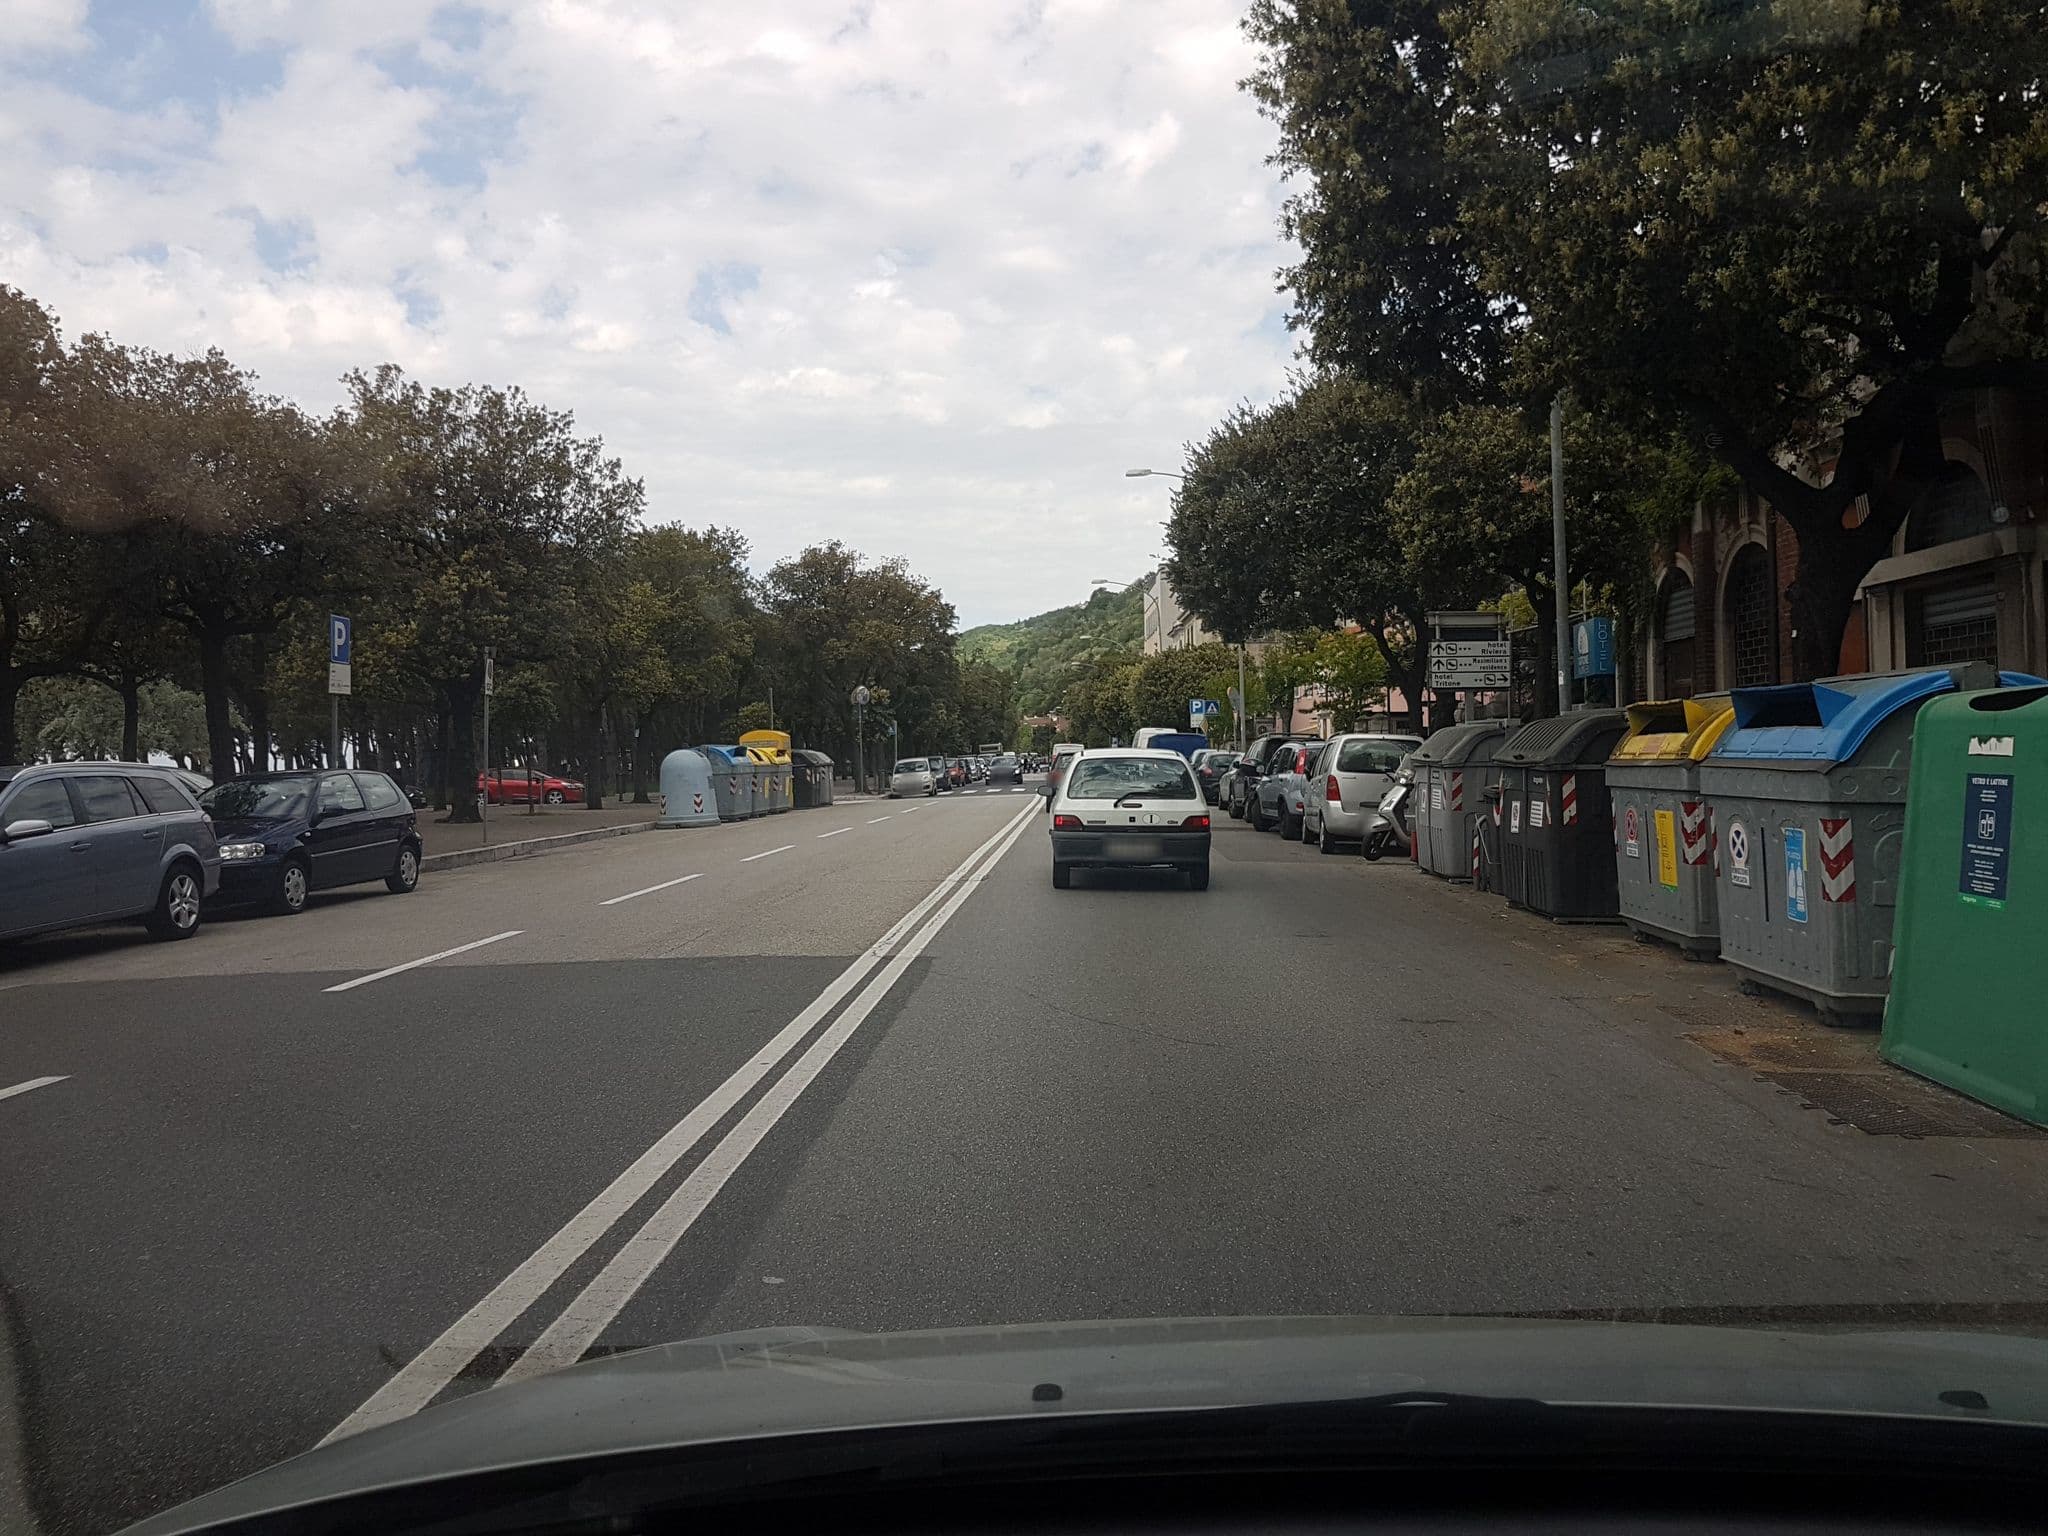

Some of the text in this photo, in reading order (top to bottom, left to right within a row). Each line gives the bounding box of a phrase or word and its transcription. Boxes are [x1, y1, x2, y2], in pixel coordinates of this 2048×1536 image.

[334, 620, 346, 657] P
[1598, 621, 1608, 671] HOTEL
[1192, 701, 1202, 713] P
